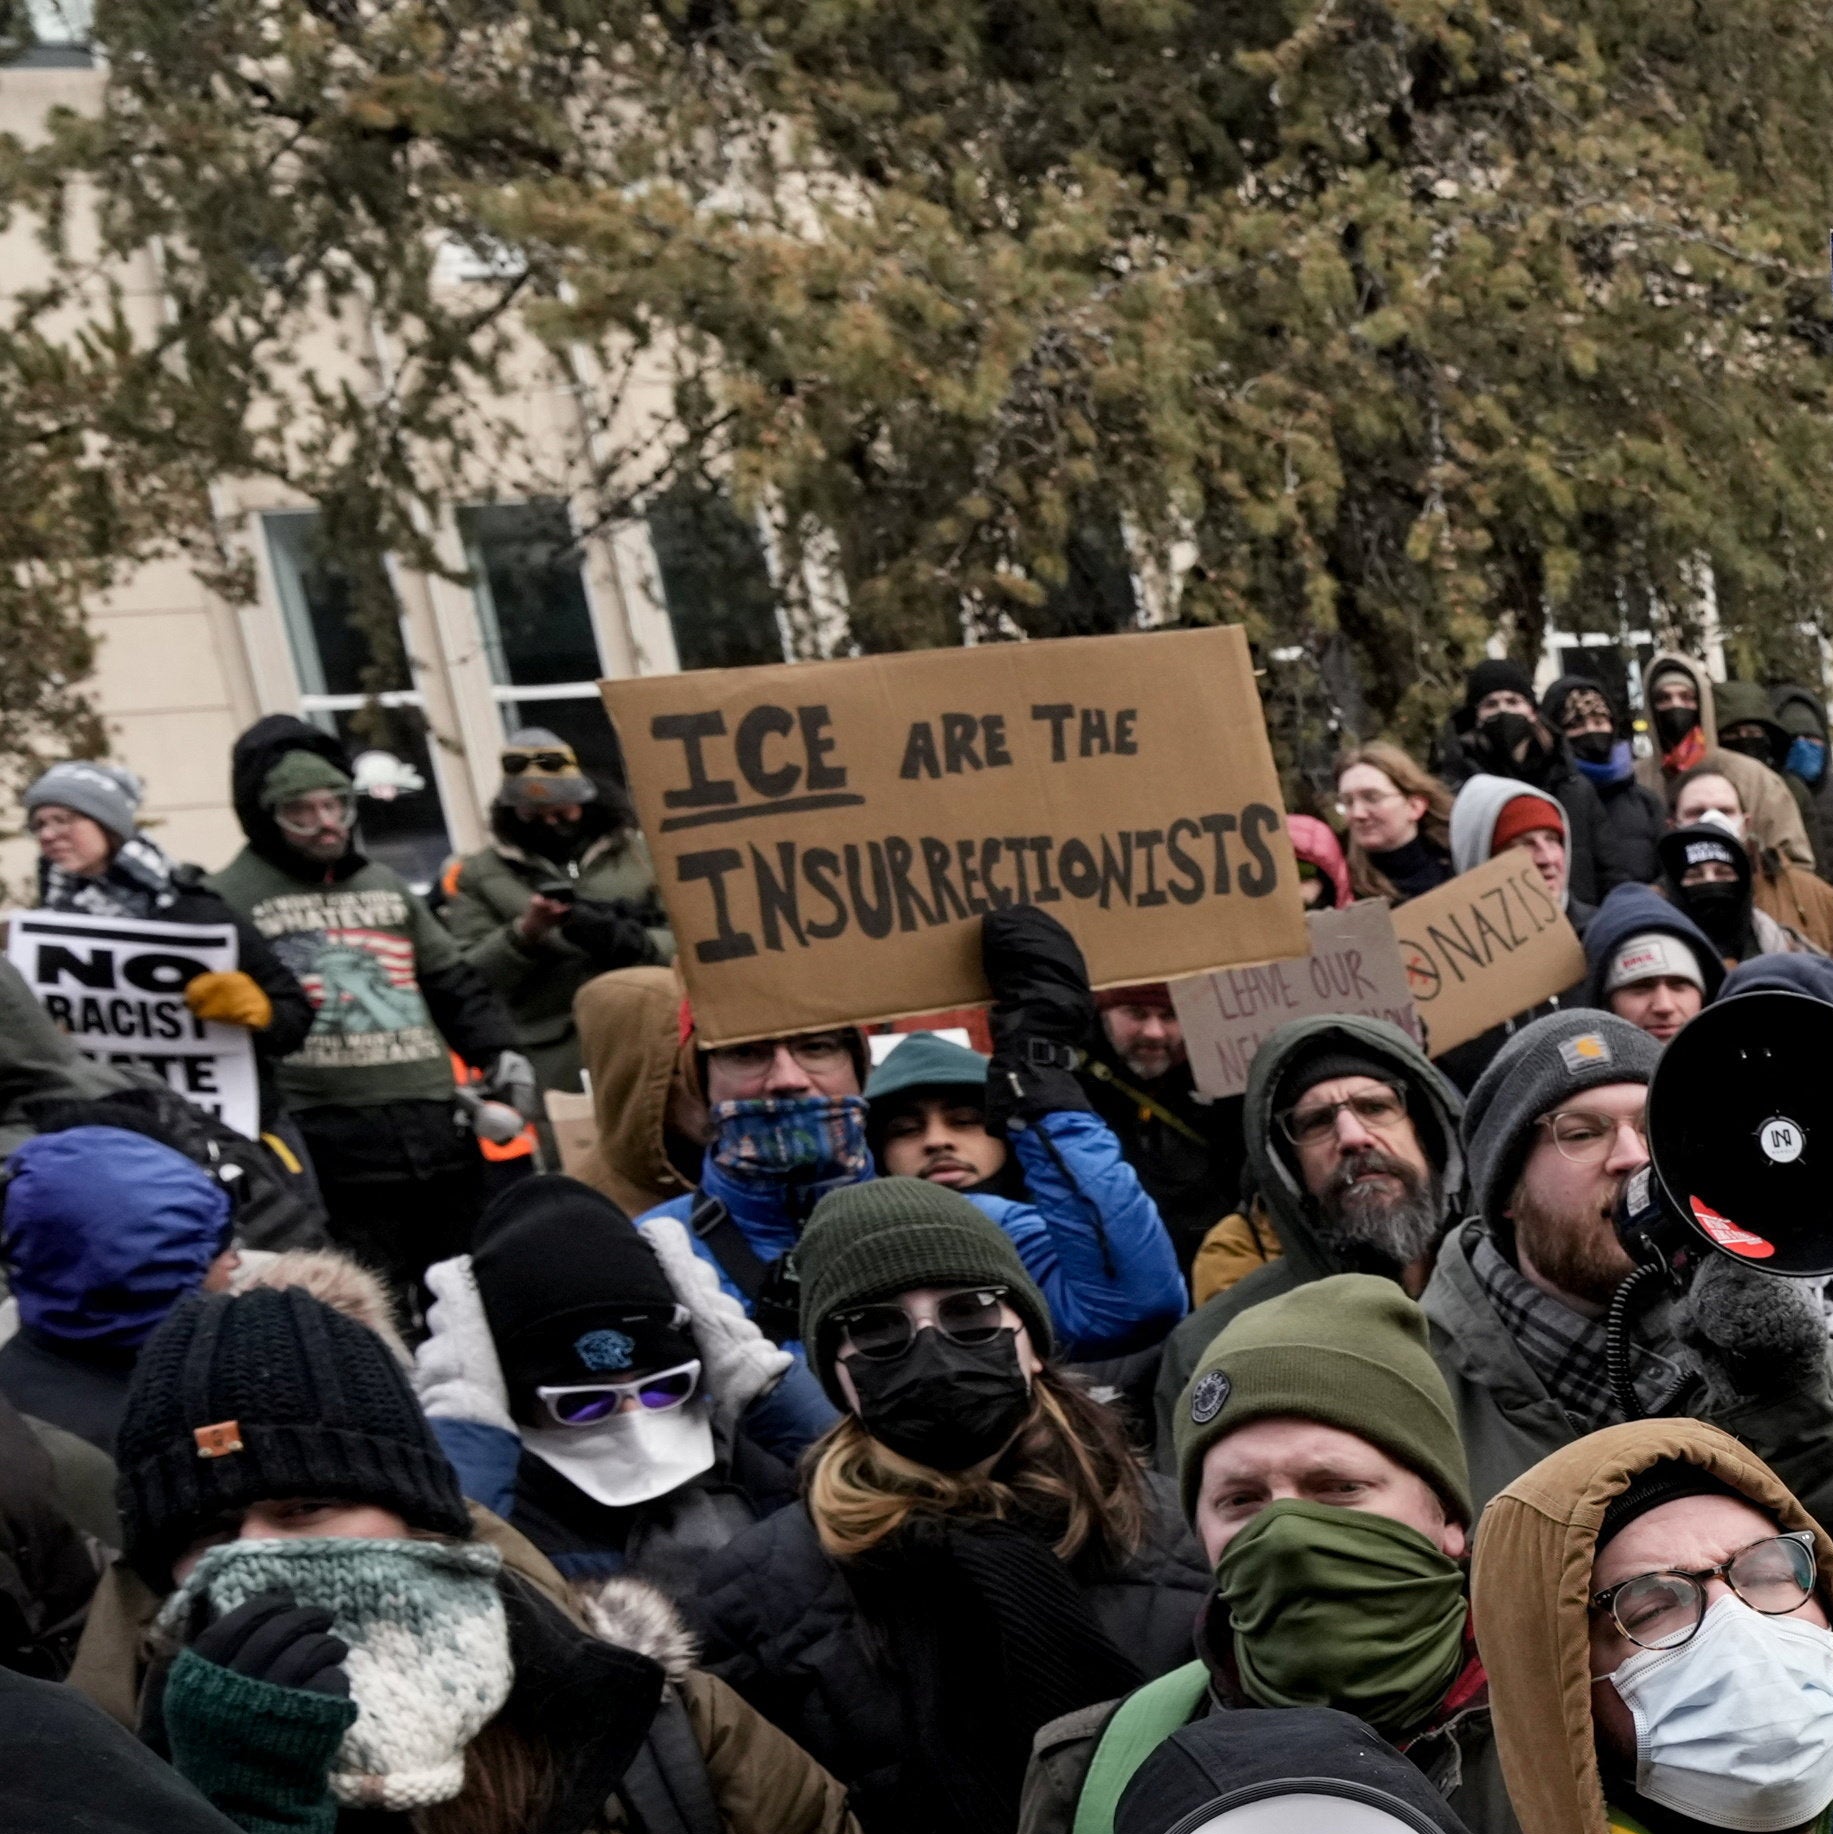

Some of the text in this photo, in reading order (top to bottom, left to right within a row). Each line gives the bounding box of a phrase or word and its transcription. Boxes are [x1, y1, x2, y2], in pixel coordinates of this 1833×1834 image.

[651, 703, 1137, 808] ICE ARE THE
[676, 803, 1279, 962] INSURRECTIONISTS
[1427, 868, 1559, 983] NAZIS
[37, 944, 213, 993] NO
[1309, 950, 1378, 1000] OUR
